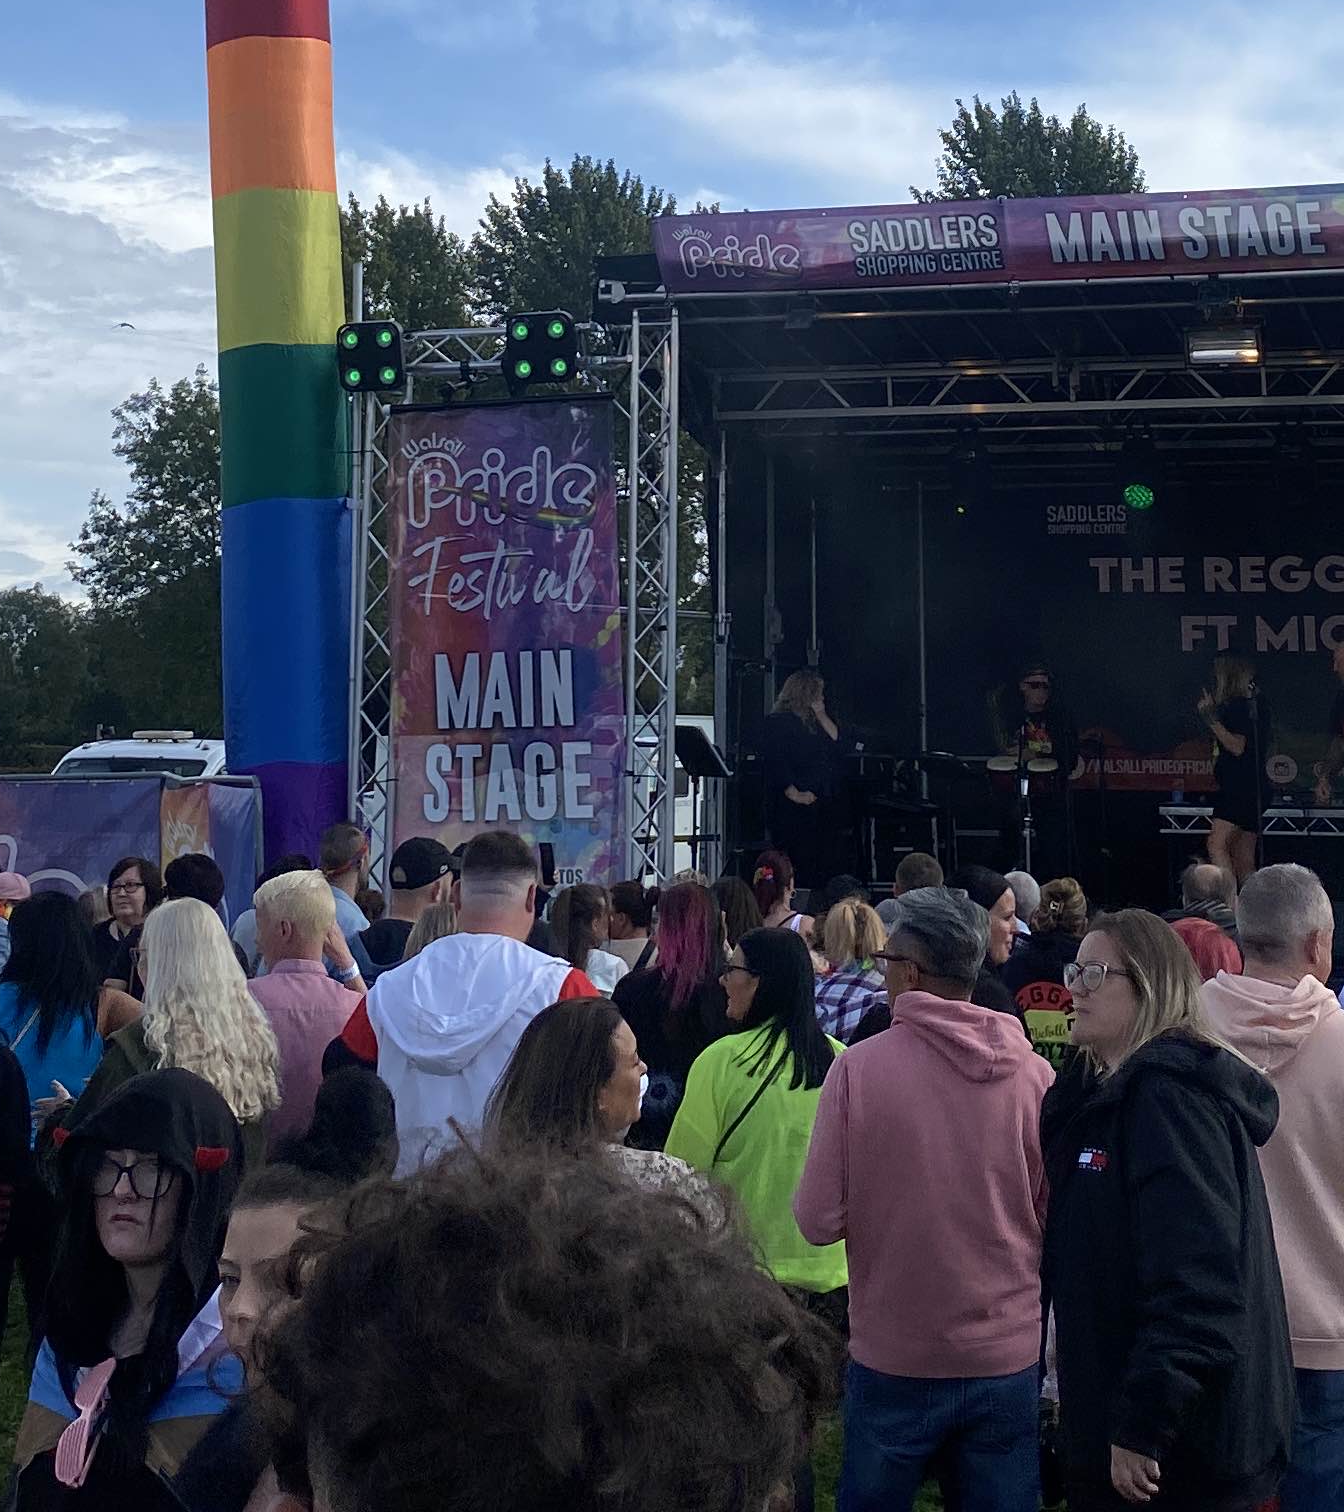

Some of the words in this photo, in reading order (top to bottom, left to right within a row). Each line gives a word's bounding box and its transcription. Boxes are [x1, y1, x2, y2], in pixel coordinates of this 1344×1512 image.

[847, 214, 999, 255] SADDLERS
[1045, 208, 1167, 264] MAIN
[1179, 199, 1327, 260] STAGE
[679, 234, 803, 280] Pride
[855, 255, 940, 278] SHOPPING
[942, 249, 1003, 273] CENTRE
[401, 432, 467, 460] Walsall
[406, 444, 598, 529] Pride
[1047, 504, 1127, 522] SADDLERS
[408, 528, 594, 620] Festival
[1090, 557, 1185, 593] THE
[1181, 615, 1238, 652] FT
[435, 649, 573, 729] MAIN
[423, 741, 594, 822] STAGE
[558, 869, 583, 884] TOS
